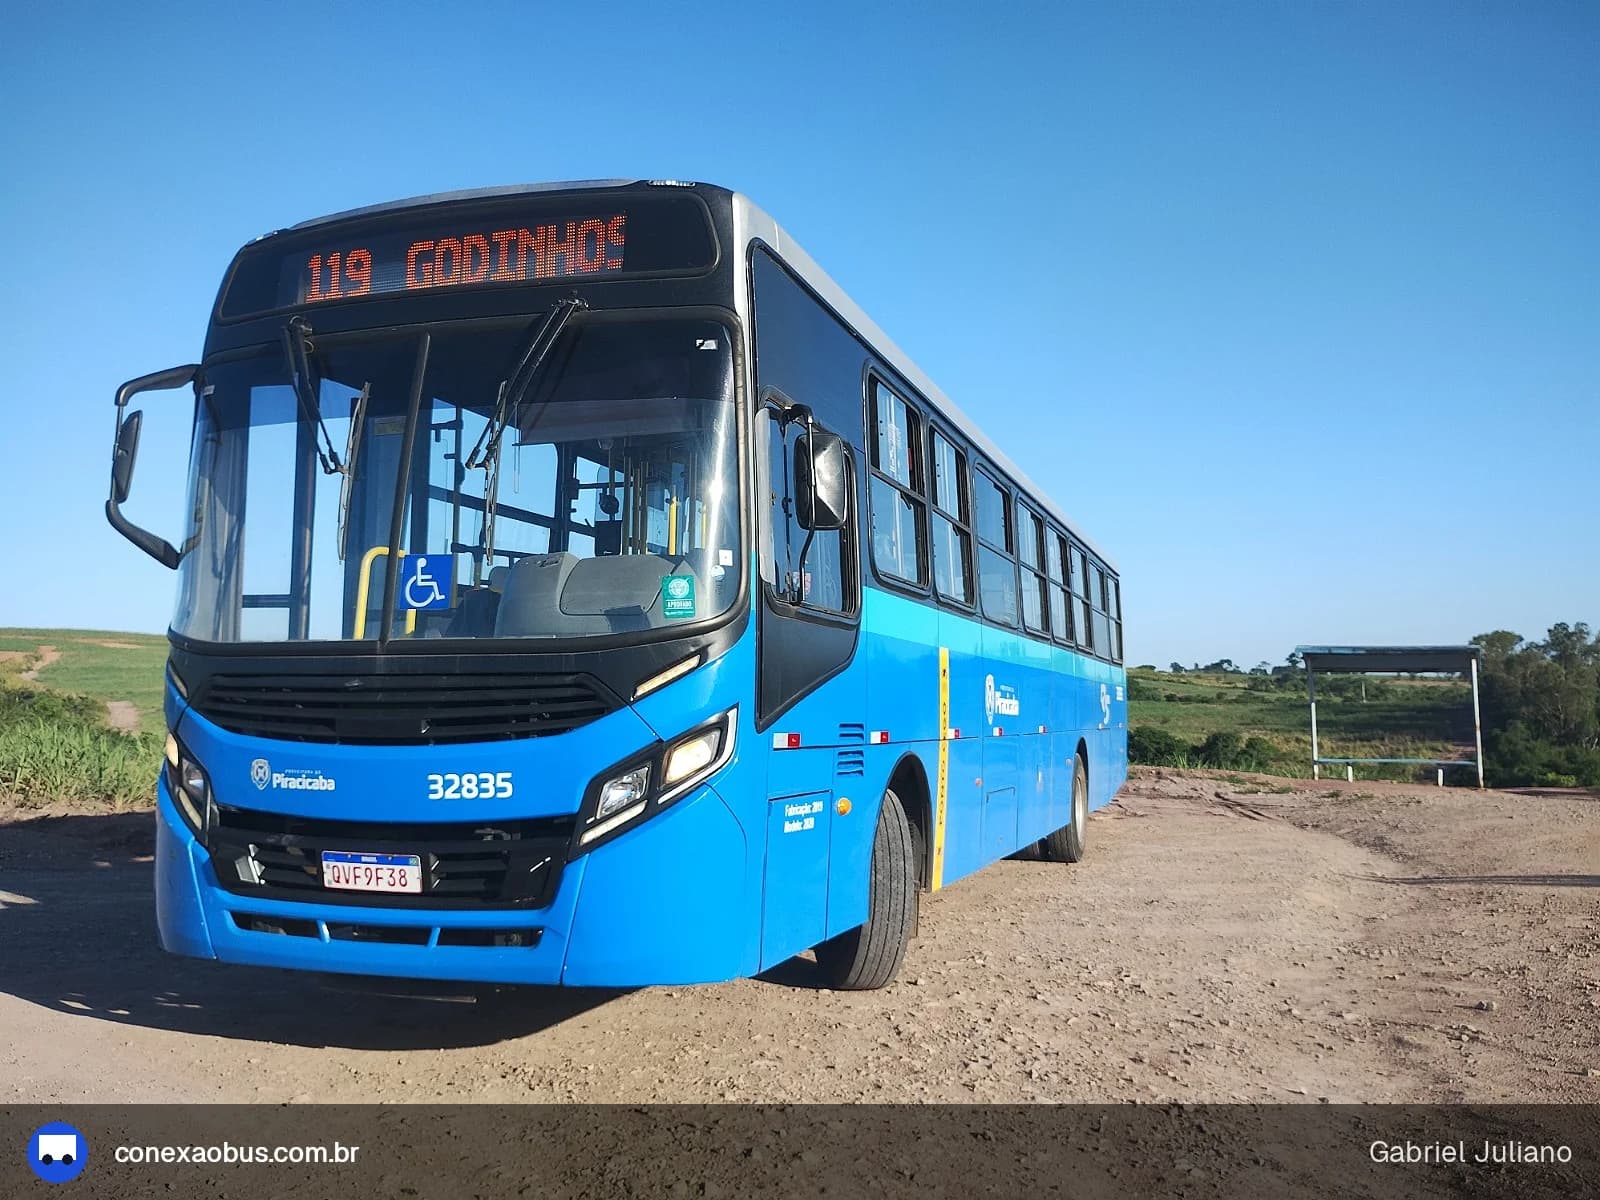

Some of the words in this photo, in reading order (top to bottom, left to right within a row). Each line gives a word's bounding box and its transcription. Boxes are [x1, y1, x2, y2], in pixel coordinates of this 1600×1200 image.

[305, 248, 372, 304] 119
[272, 773, 336, 791] Piracicaba
[427, 772, 513, 799] 32835
[332, 865, 408, 887] QVF9F38
